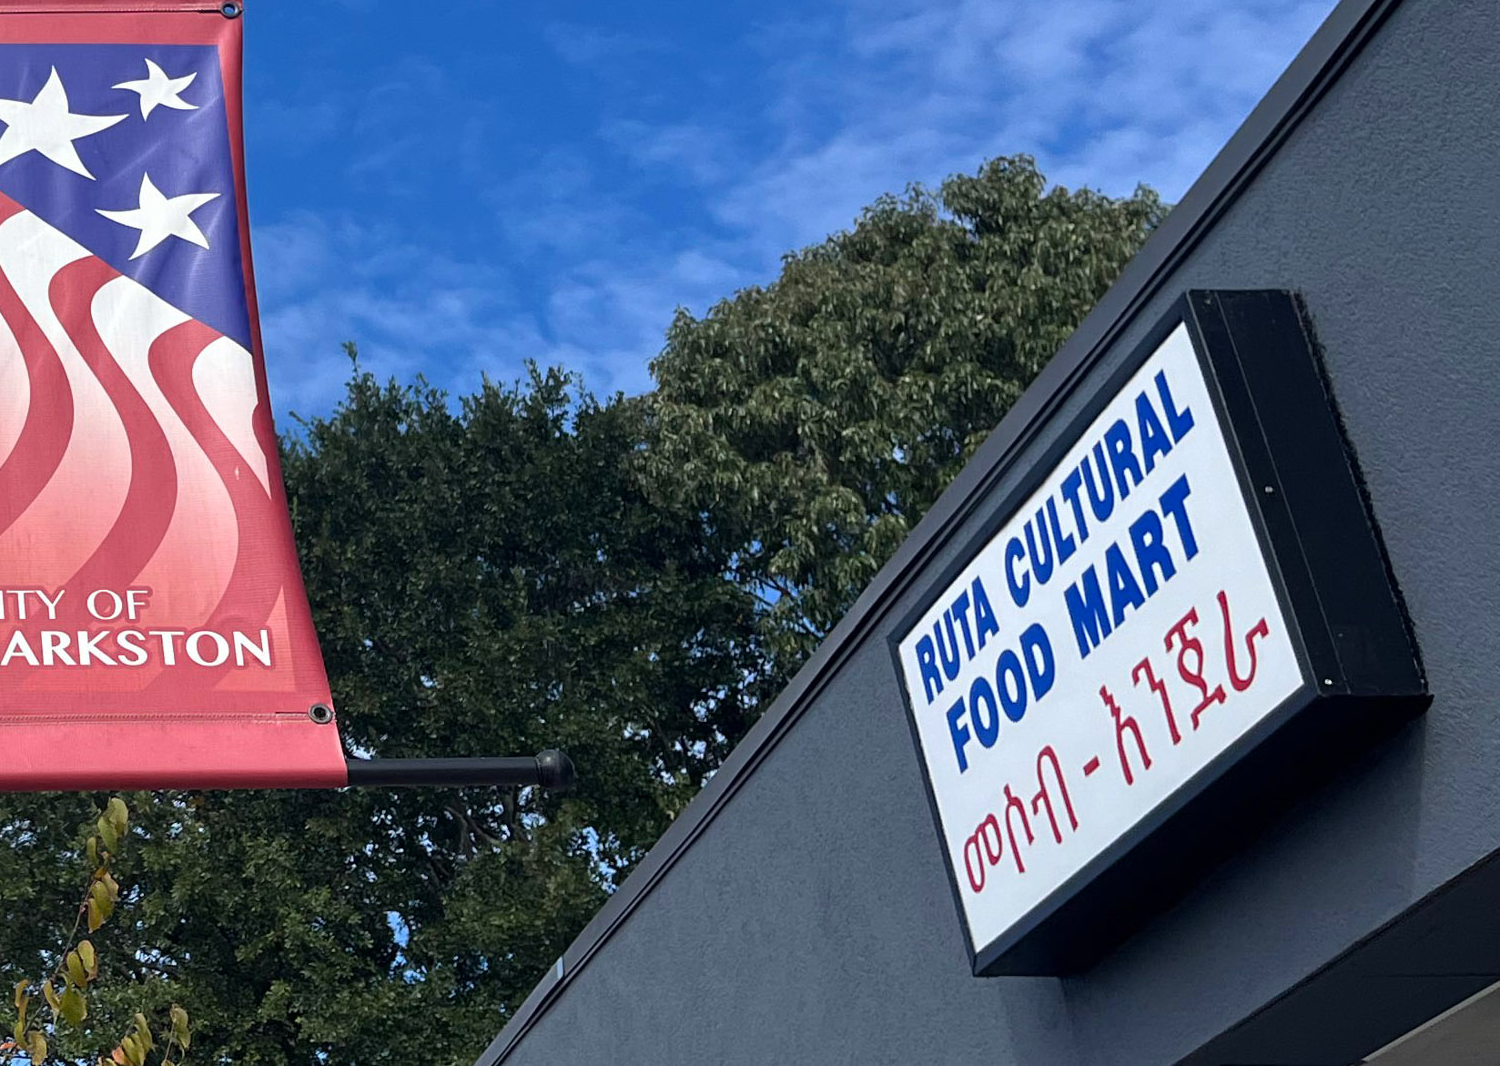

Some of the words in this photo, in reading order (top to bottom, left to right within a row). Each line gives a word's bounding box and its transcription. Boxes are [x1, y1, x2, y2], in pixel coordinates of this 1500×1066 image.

[86, 589, 149, 621] OF
[914, 575, 1000, 705] RUTA
[1002, 369, 1195, 609] CULTURAL
[945, 621, 1056, 773] FOOD
[1063, 472, 1199, 659] MART
[1099, 589, 1270, 786] እንጀራ
